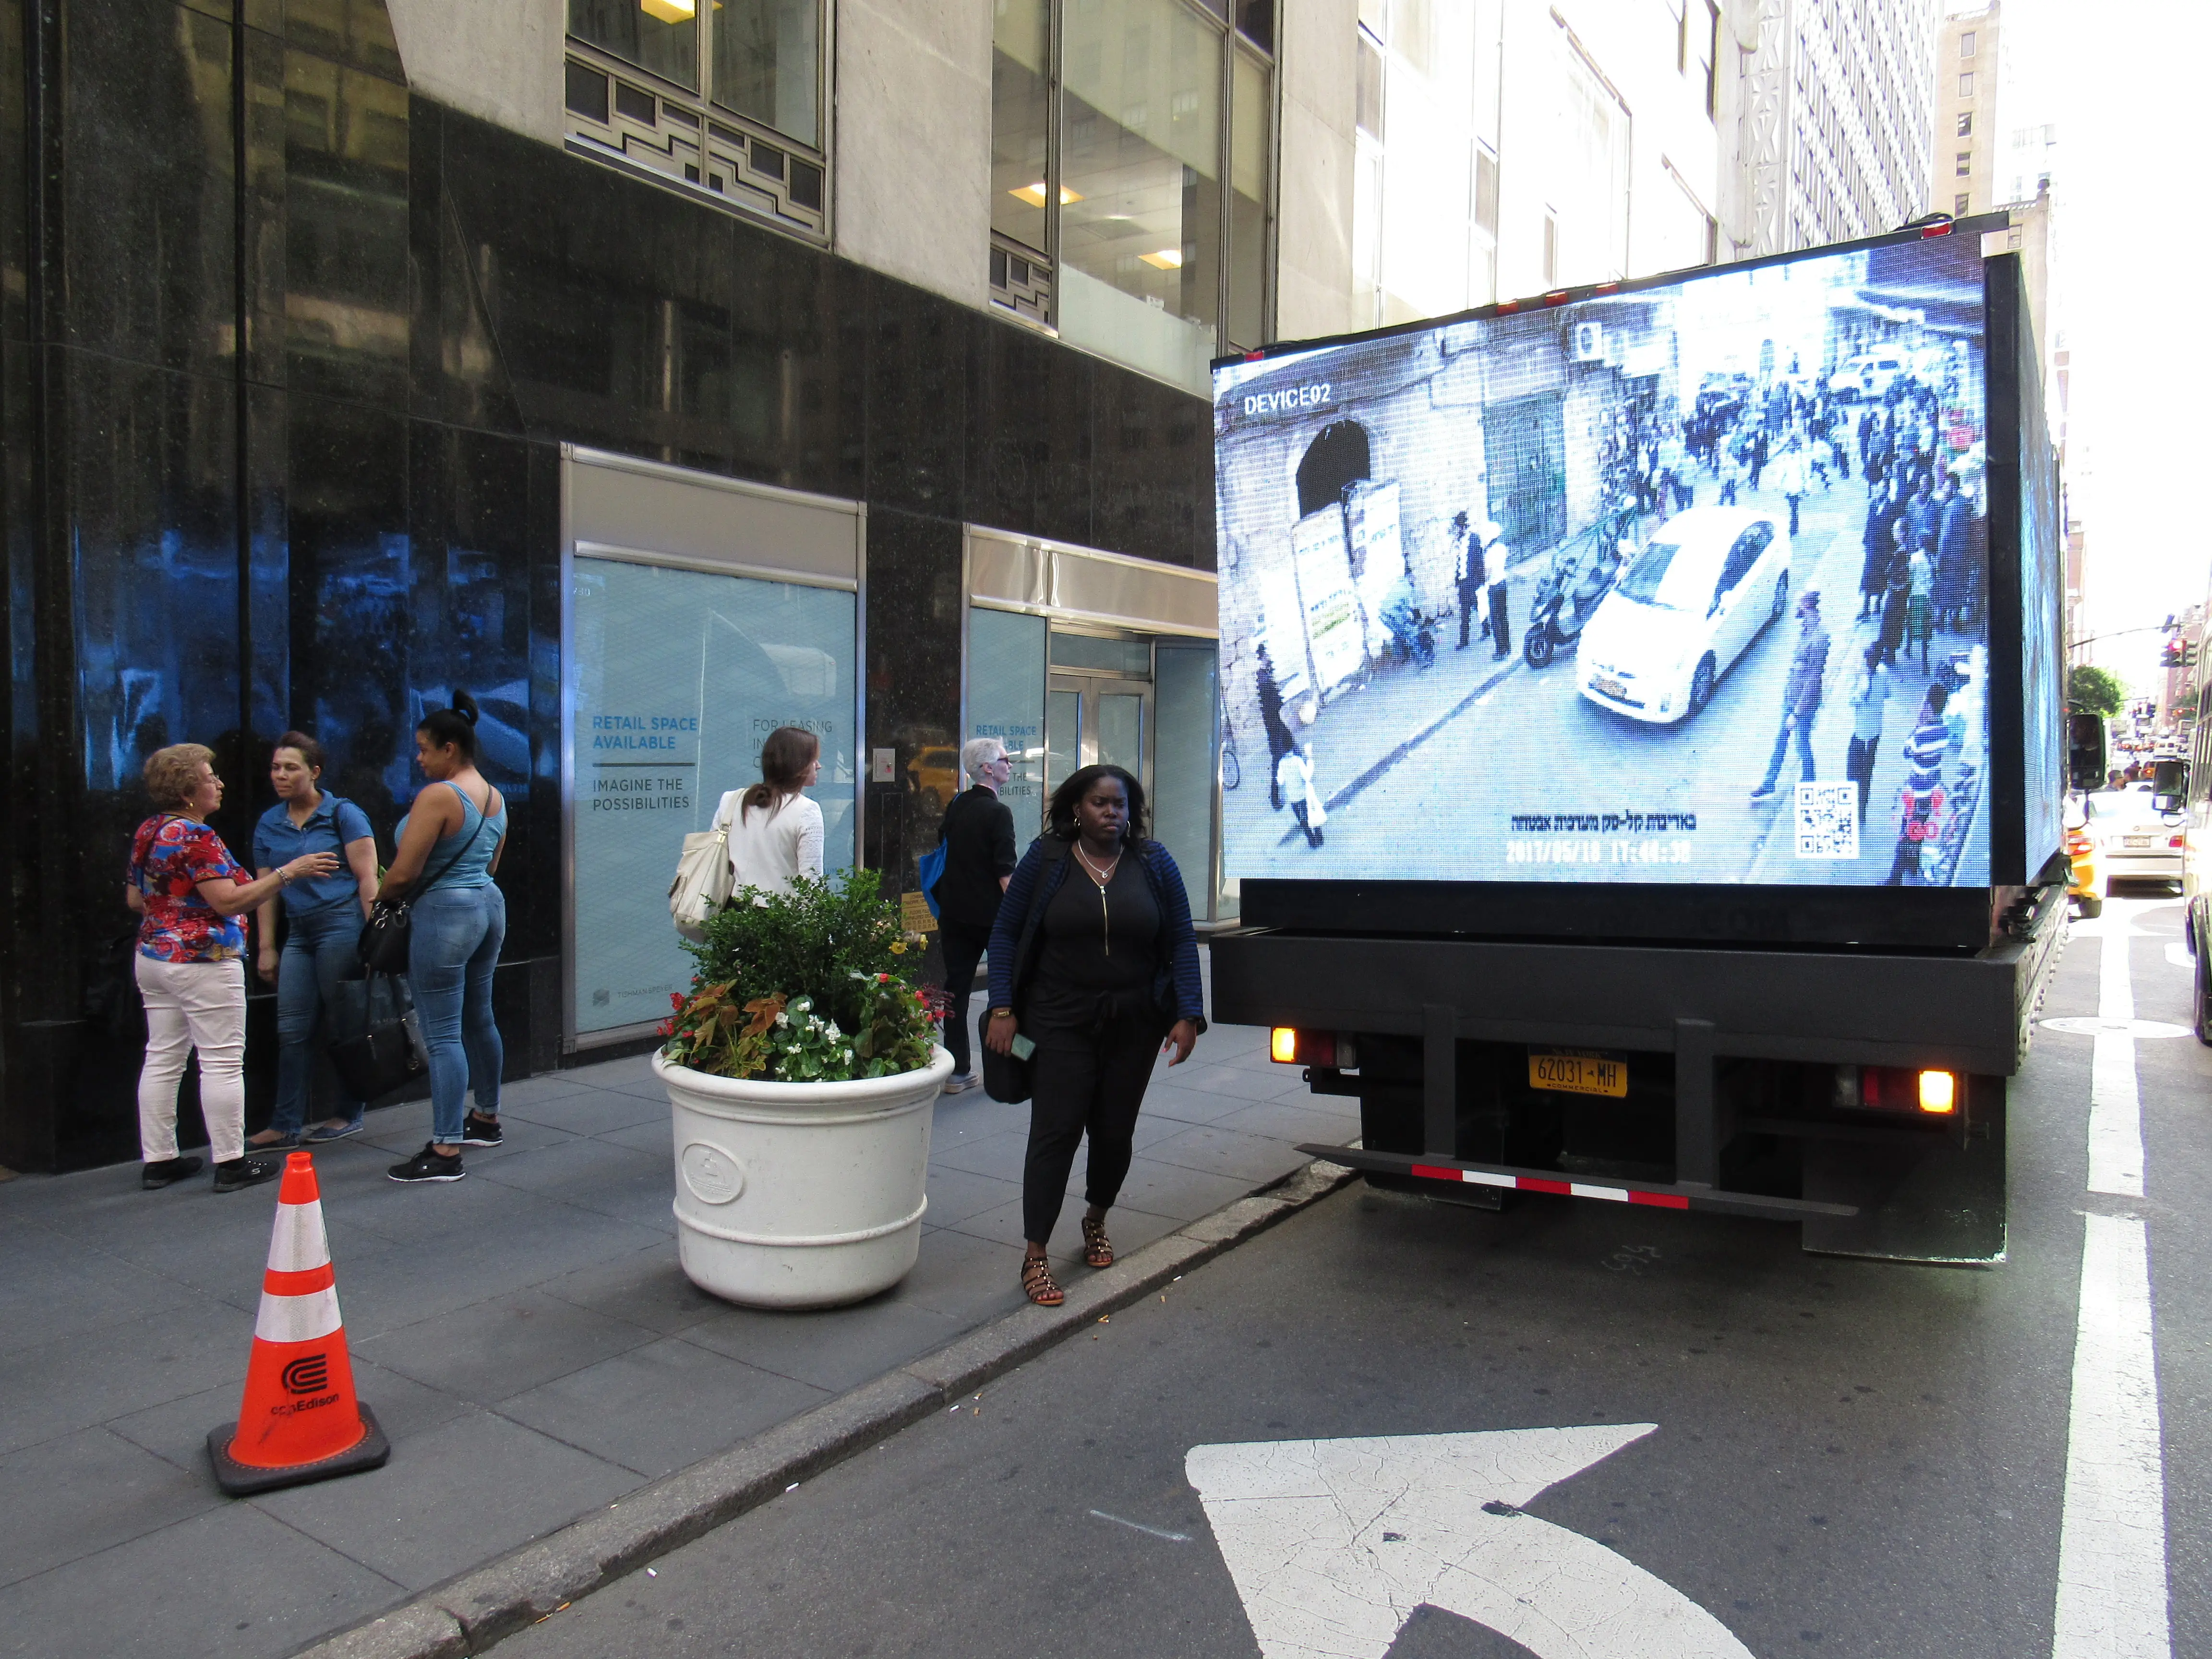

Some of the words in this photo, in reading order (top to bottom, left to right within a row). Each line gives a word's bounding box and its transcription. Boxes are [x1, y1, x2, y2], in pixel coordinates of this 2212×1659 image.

[1244, 383, 1331, 414] DEVICE02
[593, 716, 646, 730] RETAIL
[651, 717, 697, 731] SPACE
[753, 719, 778, 732] FOR
[976, 725, 1007, 736] RETAIL
[1010, 726, 1037, 736] SPACE
[593, 736, 676, 750] AVAILABLE
[1013, 773, 1027, 781] THE
[593, 779, 652, 792] IMAGINE
[658, 778, 683, 791] THE
[593, 796, 690, 811] POSSIBILITIES
[1538, 1058, 1582, 1084] 62031
[1597, 1062, 1616, 1087] MH
[1551, 1083, 1602, 1093] COMMERCIAL
